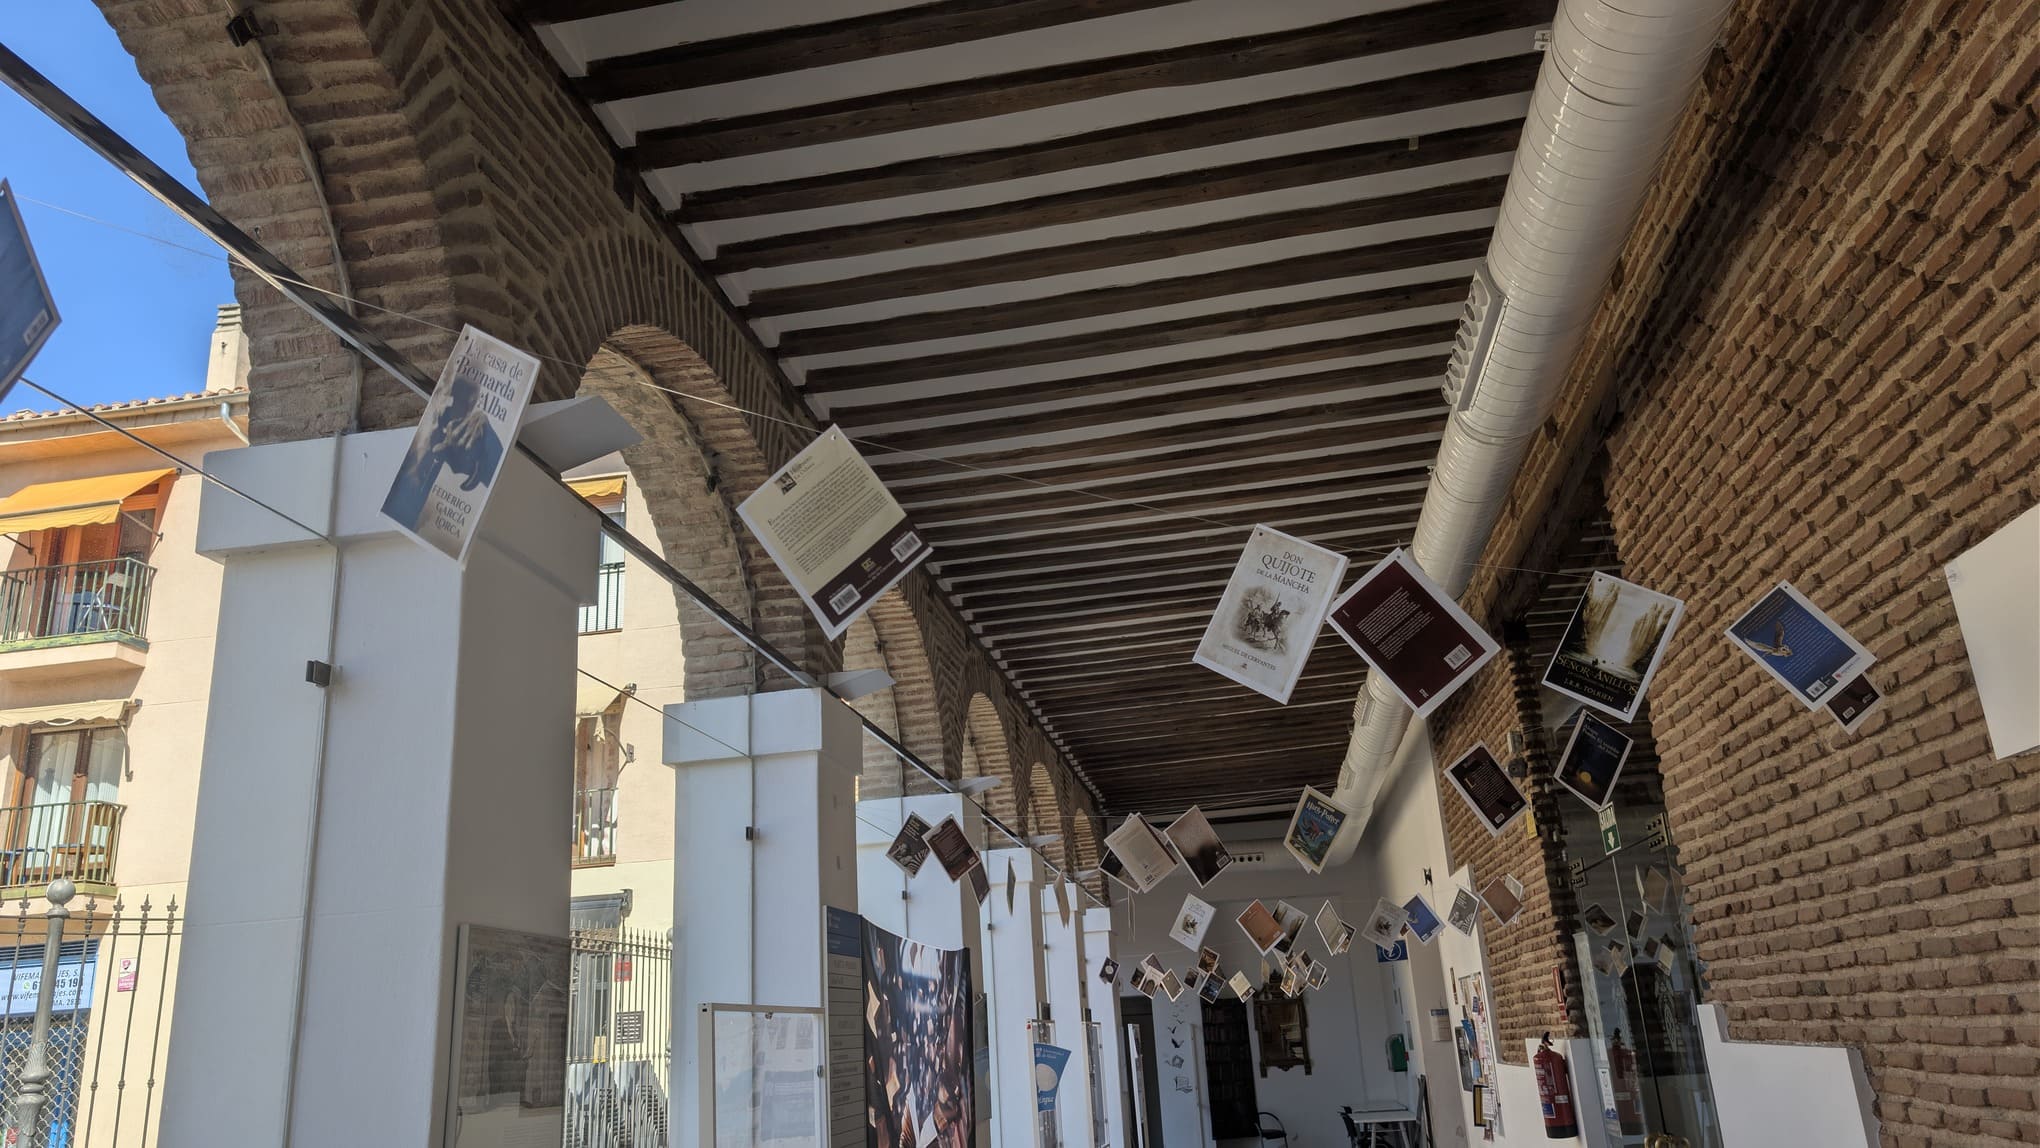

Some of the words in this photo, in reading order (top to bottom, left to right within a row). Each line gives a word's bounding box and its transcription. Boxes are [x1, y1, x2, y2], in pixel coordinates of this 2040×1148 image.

[465, 338, 482, 361] La
[482, 350, 507, 373] casa
[509, 360, 523, 380] de
[455, 355, 516, 402] Bernarda
[476, 391, 508, 422] Alba
[431, 484, 472, 514] FEDERICO
[435, 502, 466, 527] GARCÍA
[1261, 554, 1317, 584] QUIJOTE
[1283, 551, 1304, 565] DON
[1273, 572, 1310, 594] MANCHA
